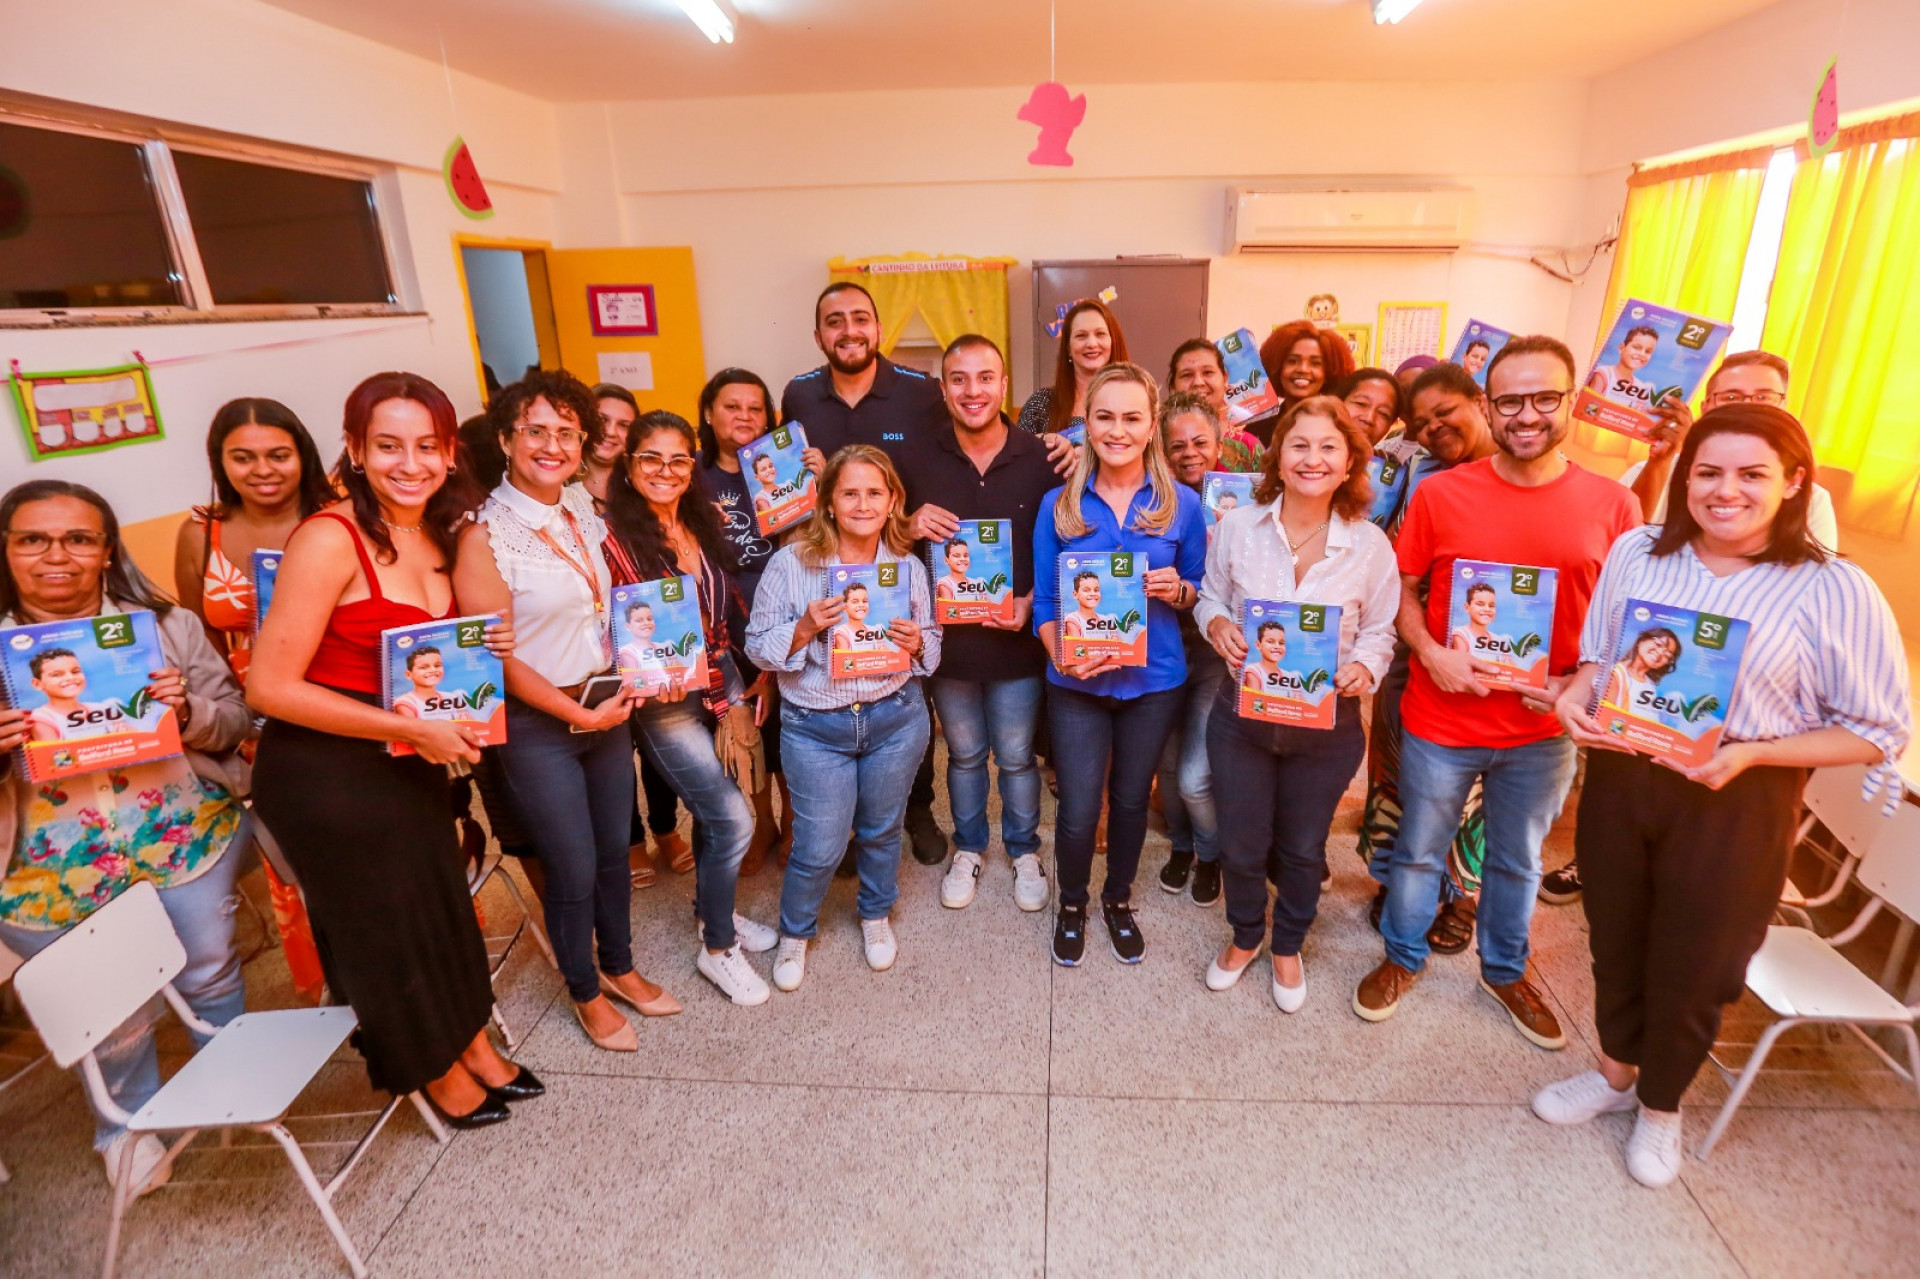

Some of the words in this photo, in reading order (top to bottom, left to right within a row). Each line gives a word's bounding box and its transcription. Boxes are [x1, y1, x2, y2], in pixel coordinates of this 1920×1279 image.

[871, 263, 915, 272] CANTINHO
[916, 262, 929, 271] DA
[930, 261, 965, 271] LEITURA
[882, 432, 904, 440] BOSS
